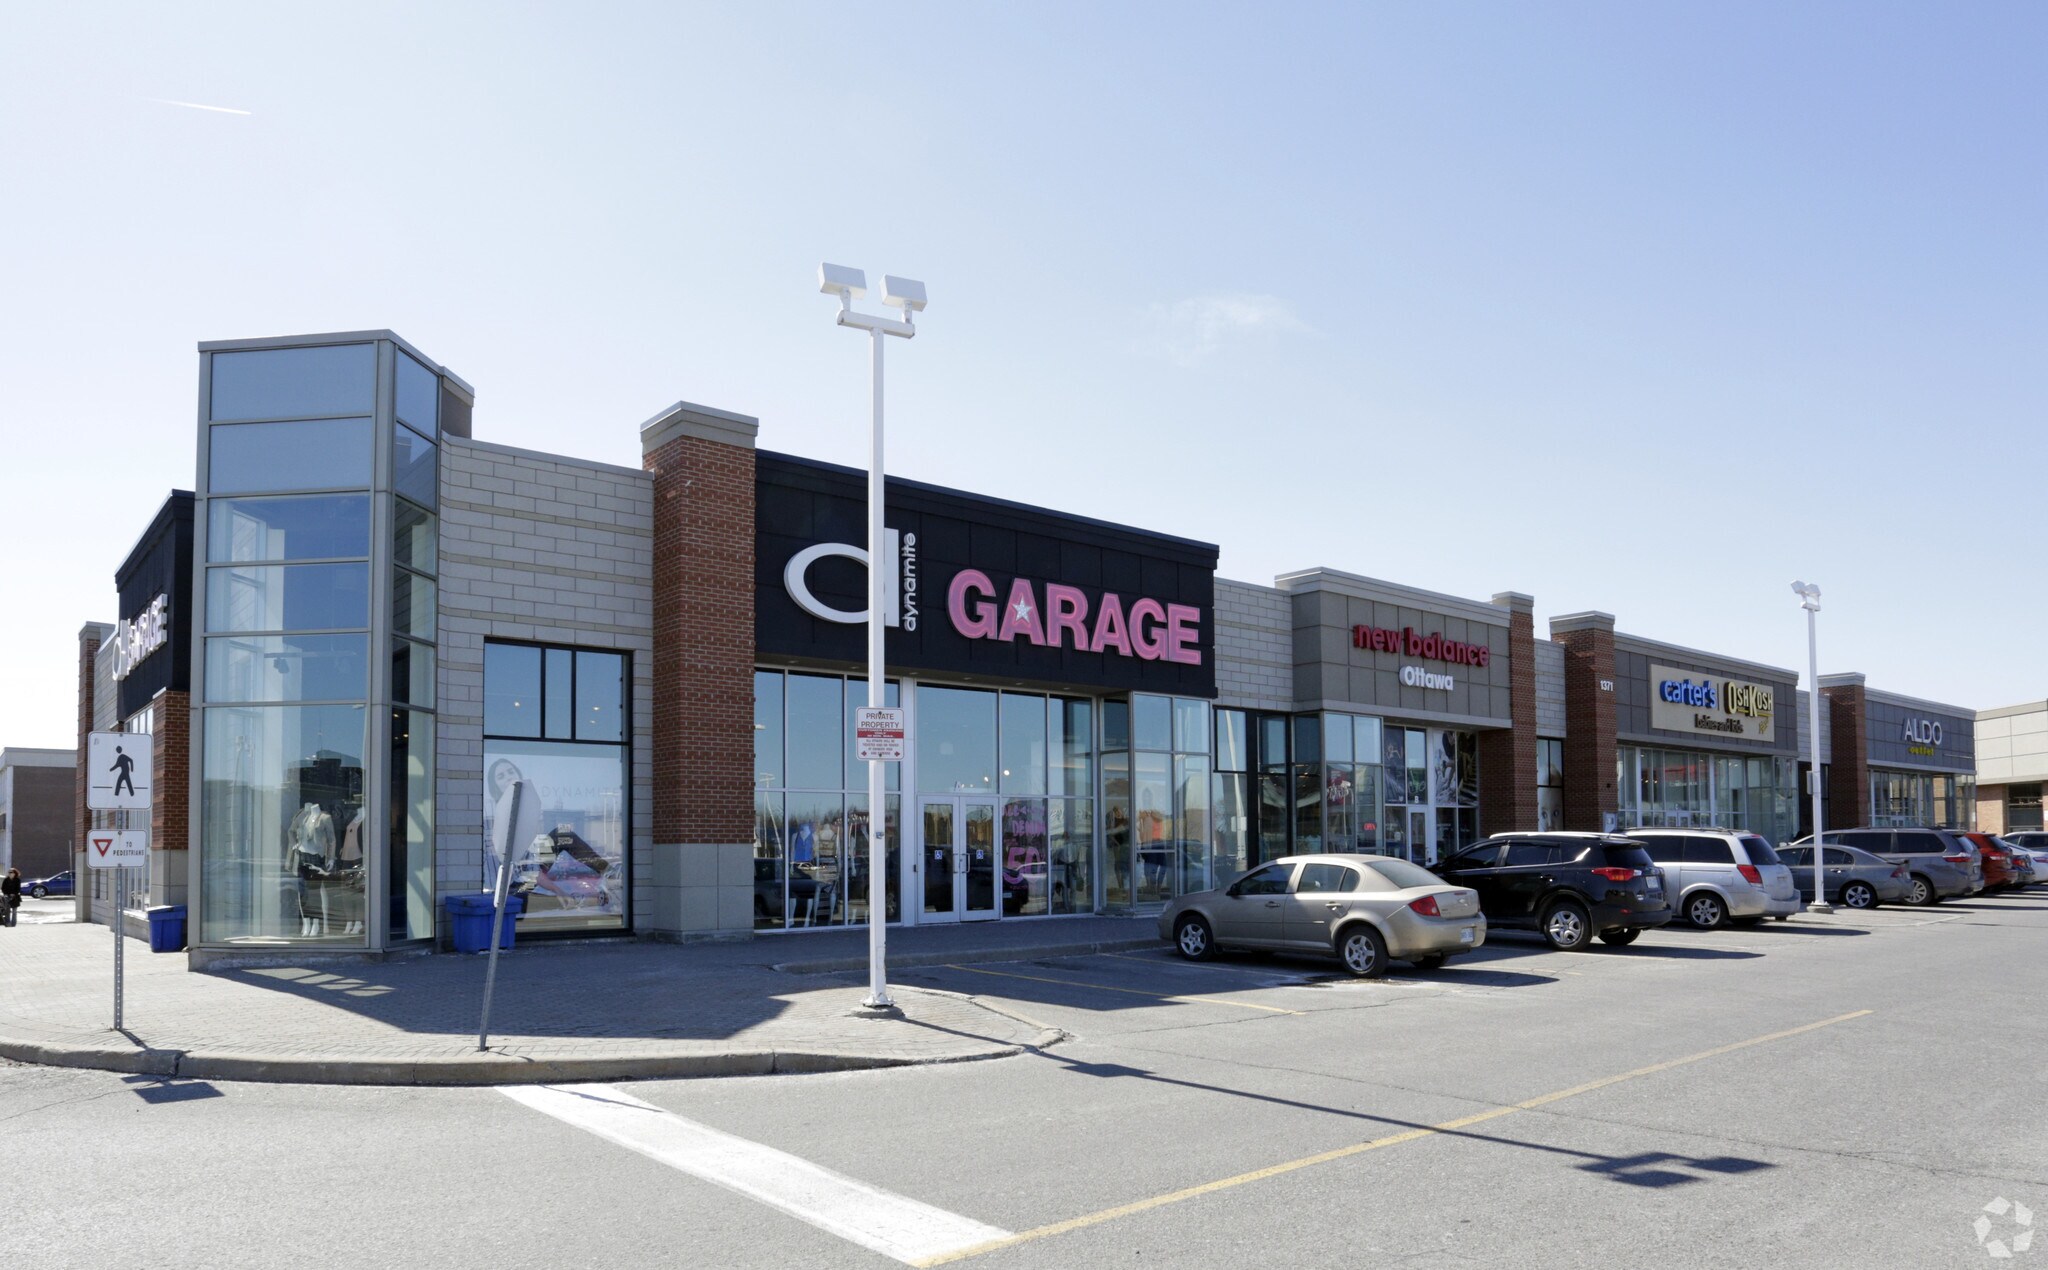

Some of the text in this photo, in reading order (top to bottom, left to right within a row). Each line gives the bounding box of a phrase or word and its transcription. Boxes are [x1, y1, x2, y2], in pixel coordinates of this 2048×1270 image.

[783, 527, 899, 627] d
[902, 532, 919, 632] dynamite
[947, 568, 1202, 666] GARAGE
[1353, 624, 1490, 668] new balance
[1399, 665, 1453, 691] Ottawa
[1600, 680, 1613, 692] 1371
[1660, 679, 1716, 709] carter's
[861, 720, 899, 729] PROPERTY
[866, 712, 894, 720] PRIVATE
[1903, 718, 1942, 745] ALDO
[113, 849, 145, 857] PEDESTRIANS
